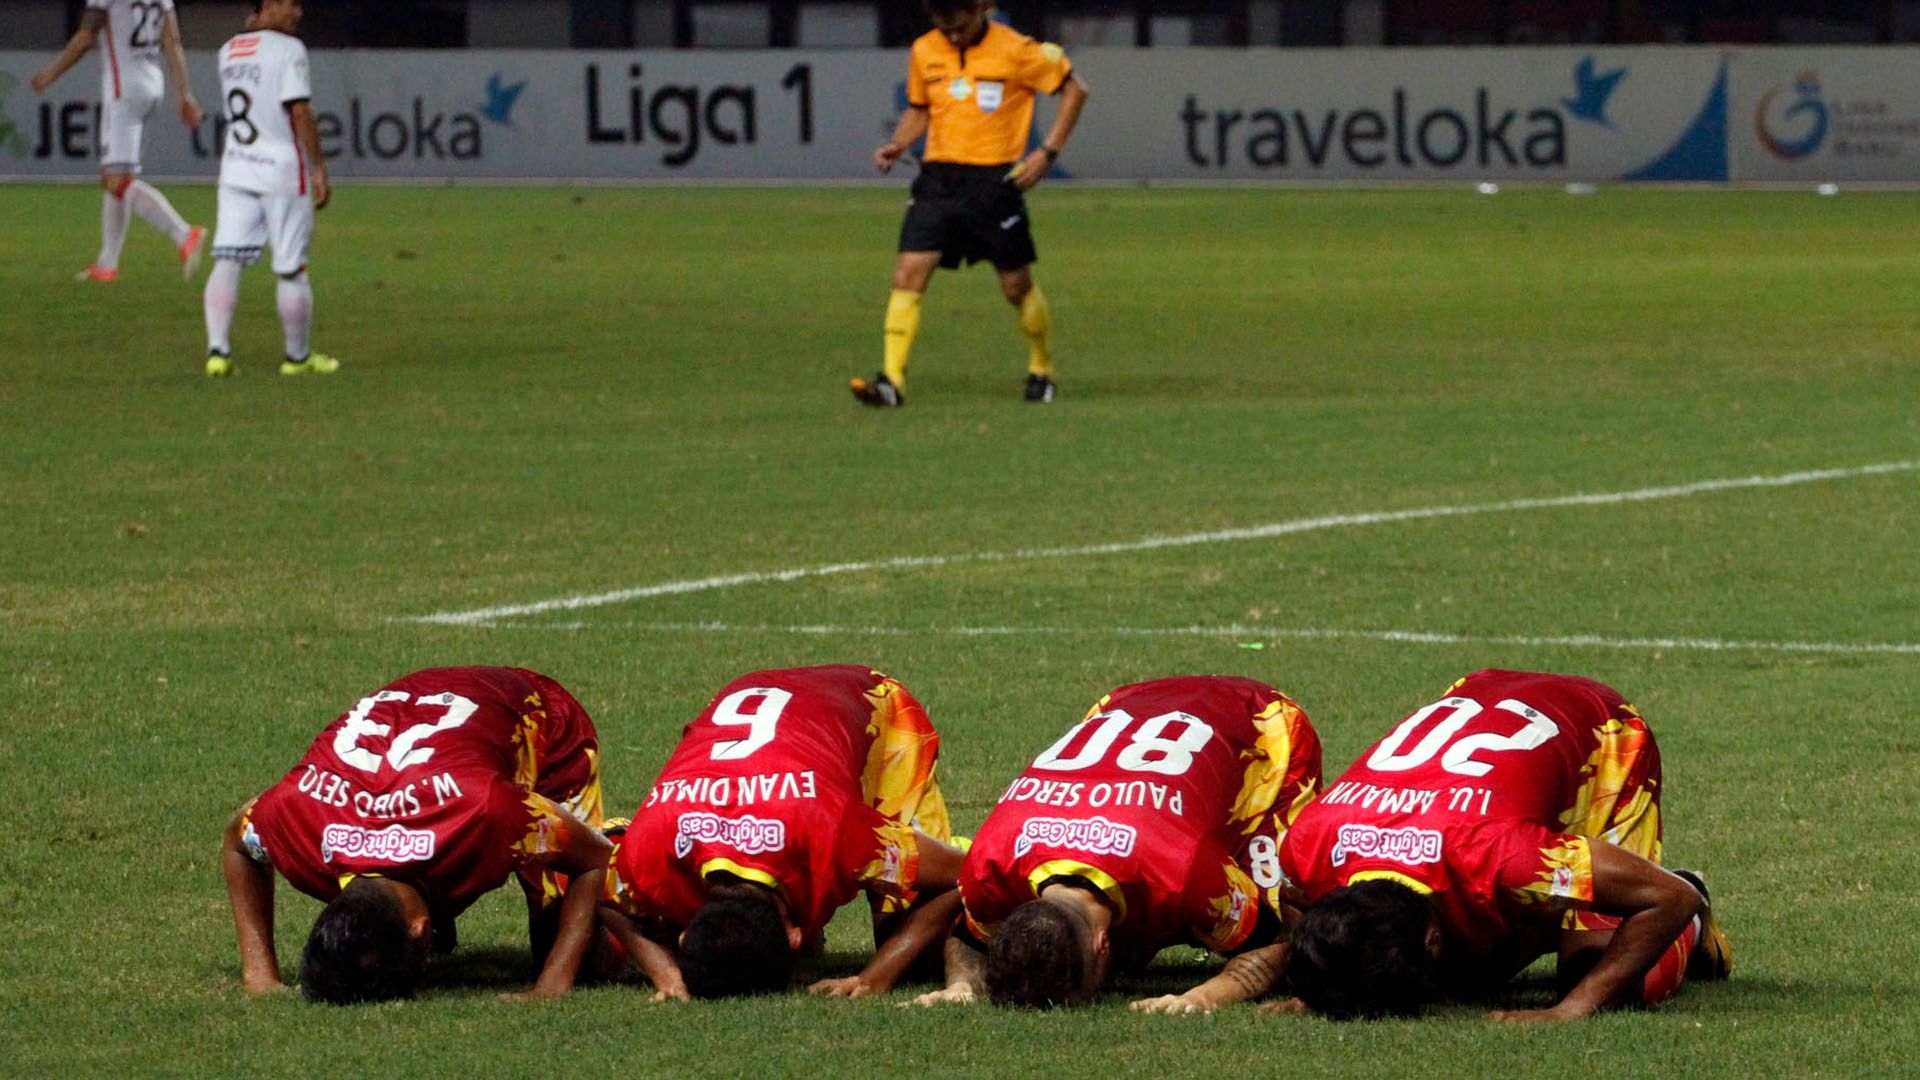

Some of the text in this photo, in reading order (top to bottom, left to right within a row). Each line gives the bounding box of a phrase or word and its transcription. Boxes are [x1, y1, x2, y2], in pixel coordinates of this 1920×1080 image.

[35, 101, 105, 158] JE
[188, 101, 483, 160] treloka
[228, 87, 259, 145] 8
[586, 63, 813, 167] Liga 1
[1179, 87, 1568, 168] traveloka
[333, 690, 479, 774] 23
[710, 687, 793, 760] 6
[1032, 708, 1214, 776] 80
[1366, 696, 1560, 777] 20
[298, 764, 463, 819] W. SUBO SETO
[737, 770, 817, 806] EVAN
[1090, 781, 1184, 816] PAULO
[1319, 781, 1440, 815] ARMAIYN
[325, 828, 431, 859] Bright Gas
[680, 816, 780, 851] Bright Gas
[1025, 820, 1131, 853] Bright Gas
[1340, 828, 1440, 863] Bright Gas
[1248, 836, 1281, 889] 8
